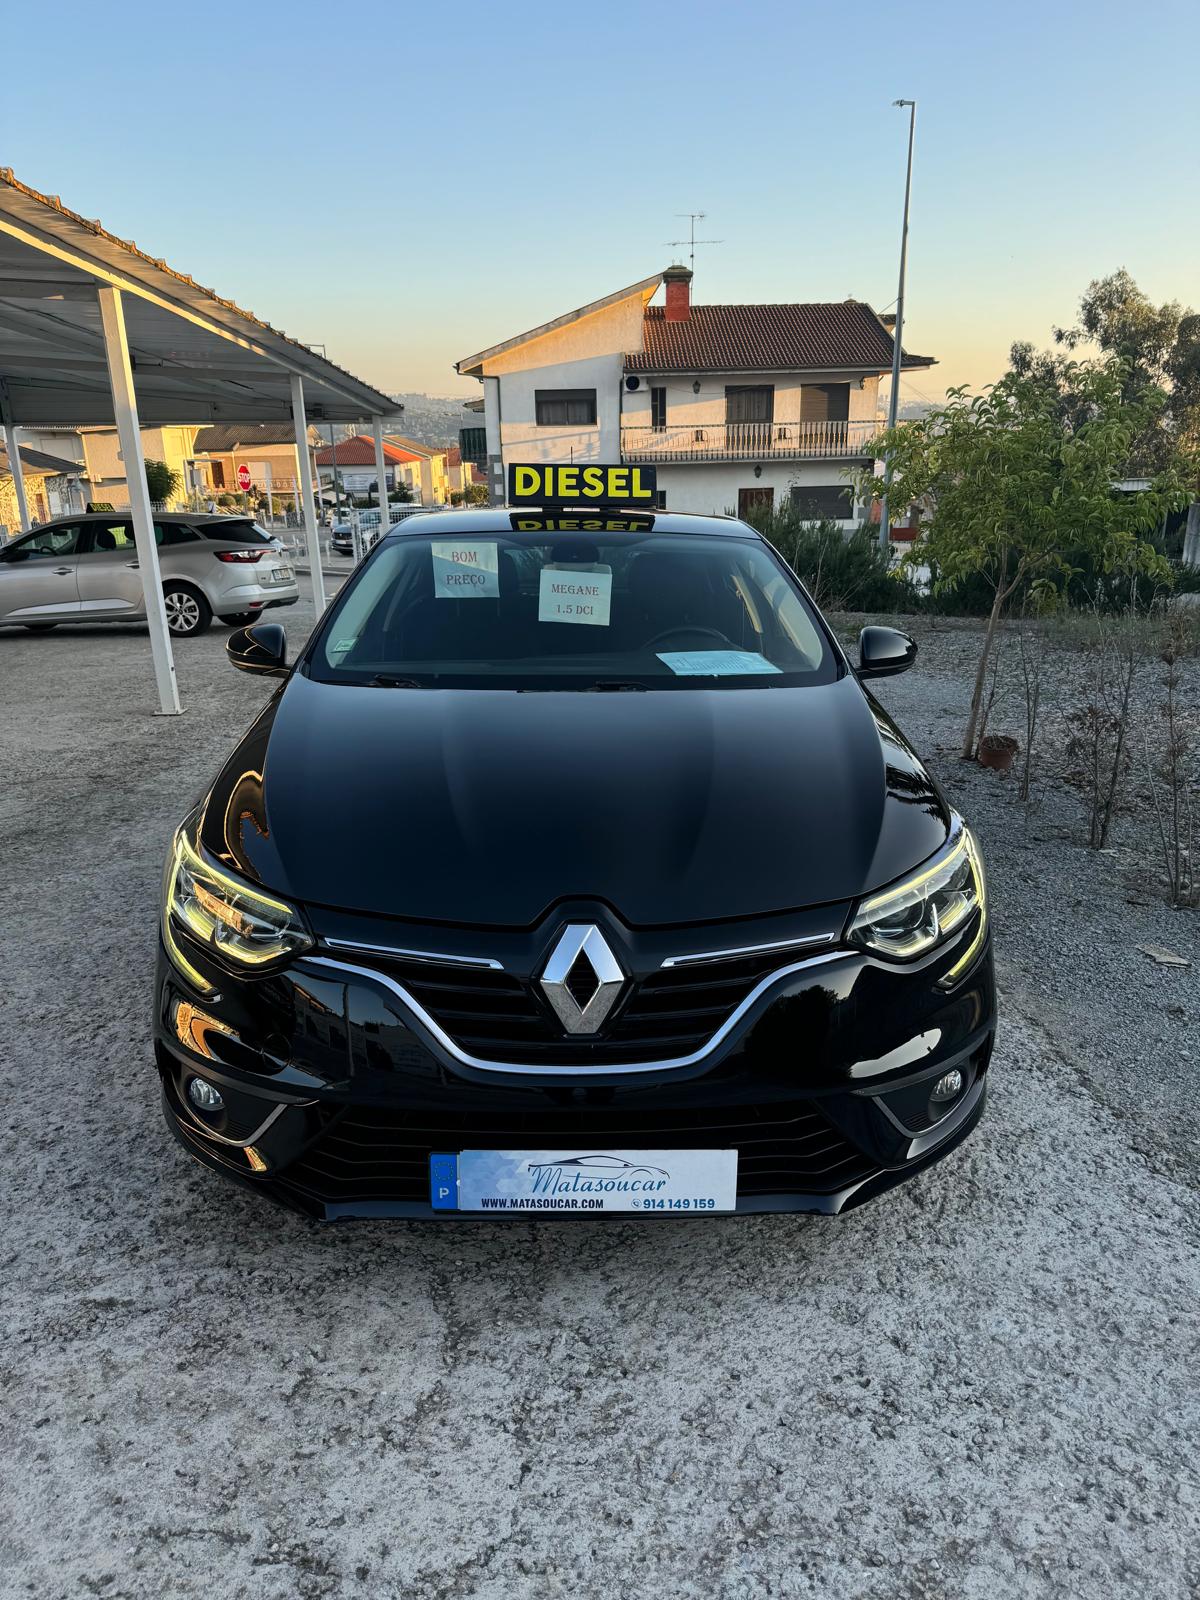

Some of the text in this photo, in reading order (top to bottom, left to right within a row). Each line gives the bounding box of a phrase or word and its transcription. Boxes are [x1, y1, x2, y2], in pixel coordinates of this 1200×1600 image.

[238, 472, 250, 483] STOP
[515, 466, 652, 498] DIESEL
[451, 551, 478, 563] BOM
[446, 574, 486, 587] PREÇO
[551, 583, 600, 596] MEGANE
[556, 604, 593, 615] 1.5 DCI
[531, 1166, 667, 1195] Matasoucar
[439, 1187, 450, 1199] P
[481, 1198, 604, 1209] WWW.MATASOUCAR.COM
[643, 1199, 716, 1209] 914 149 159
